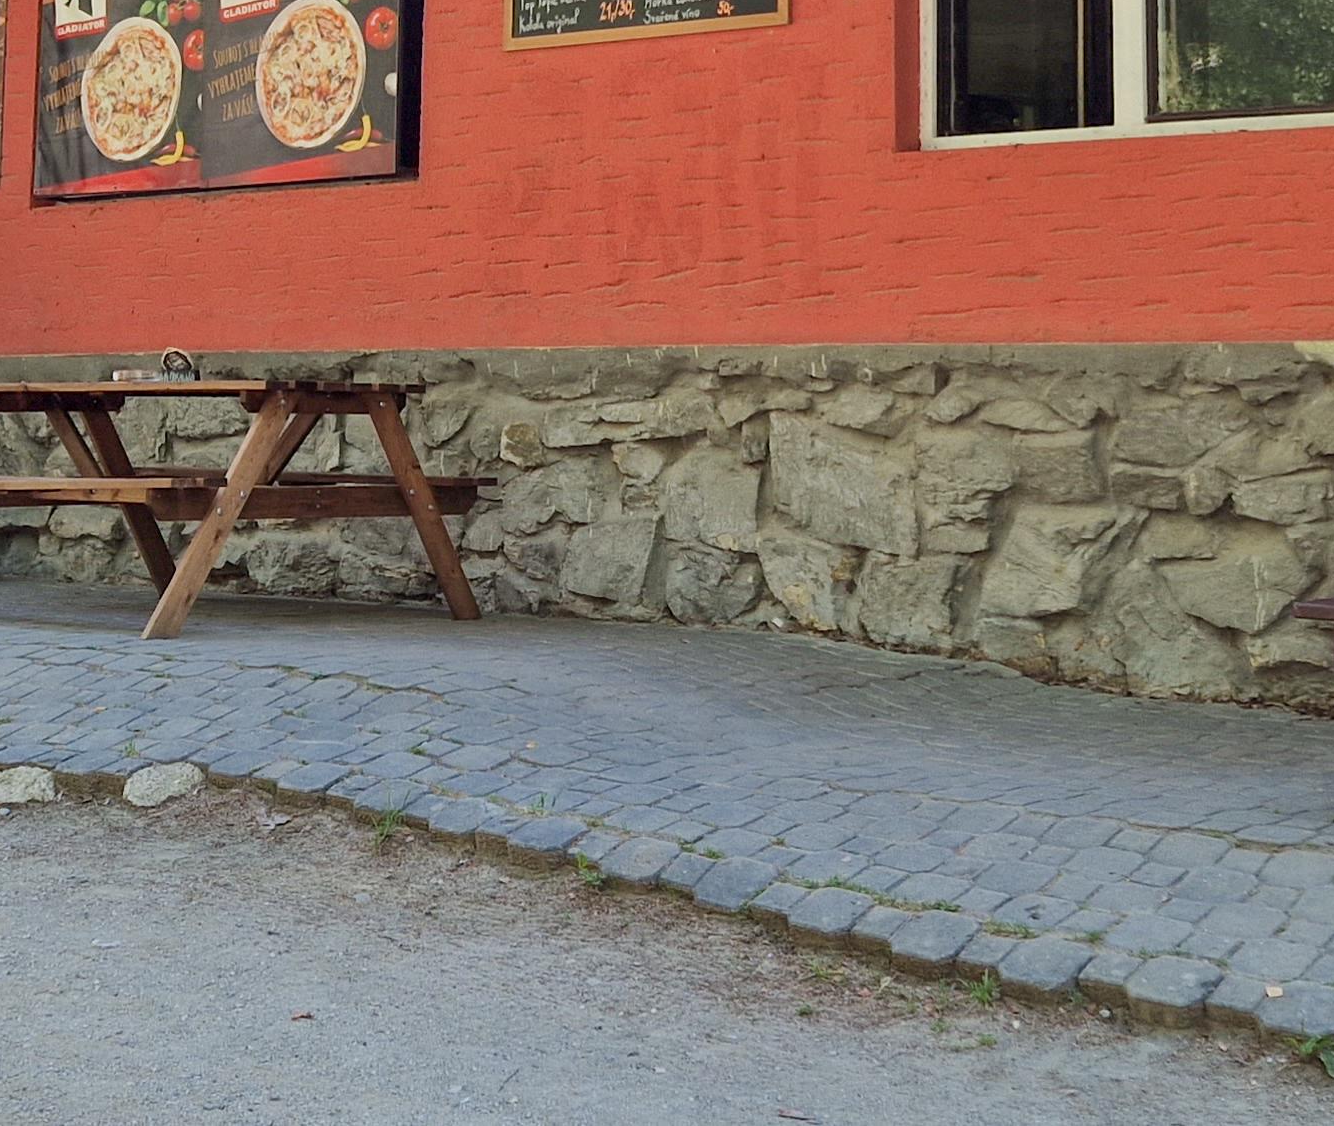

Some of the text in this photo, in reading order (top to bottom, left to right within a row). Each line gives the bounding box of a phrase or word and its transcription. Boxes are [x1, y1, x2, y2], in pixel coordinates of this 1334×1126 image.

[546, 7, 580, 35] original
[681, 8, 700, 20] víno
[57, 18, 106, 37] GLADIATOR
